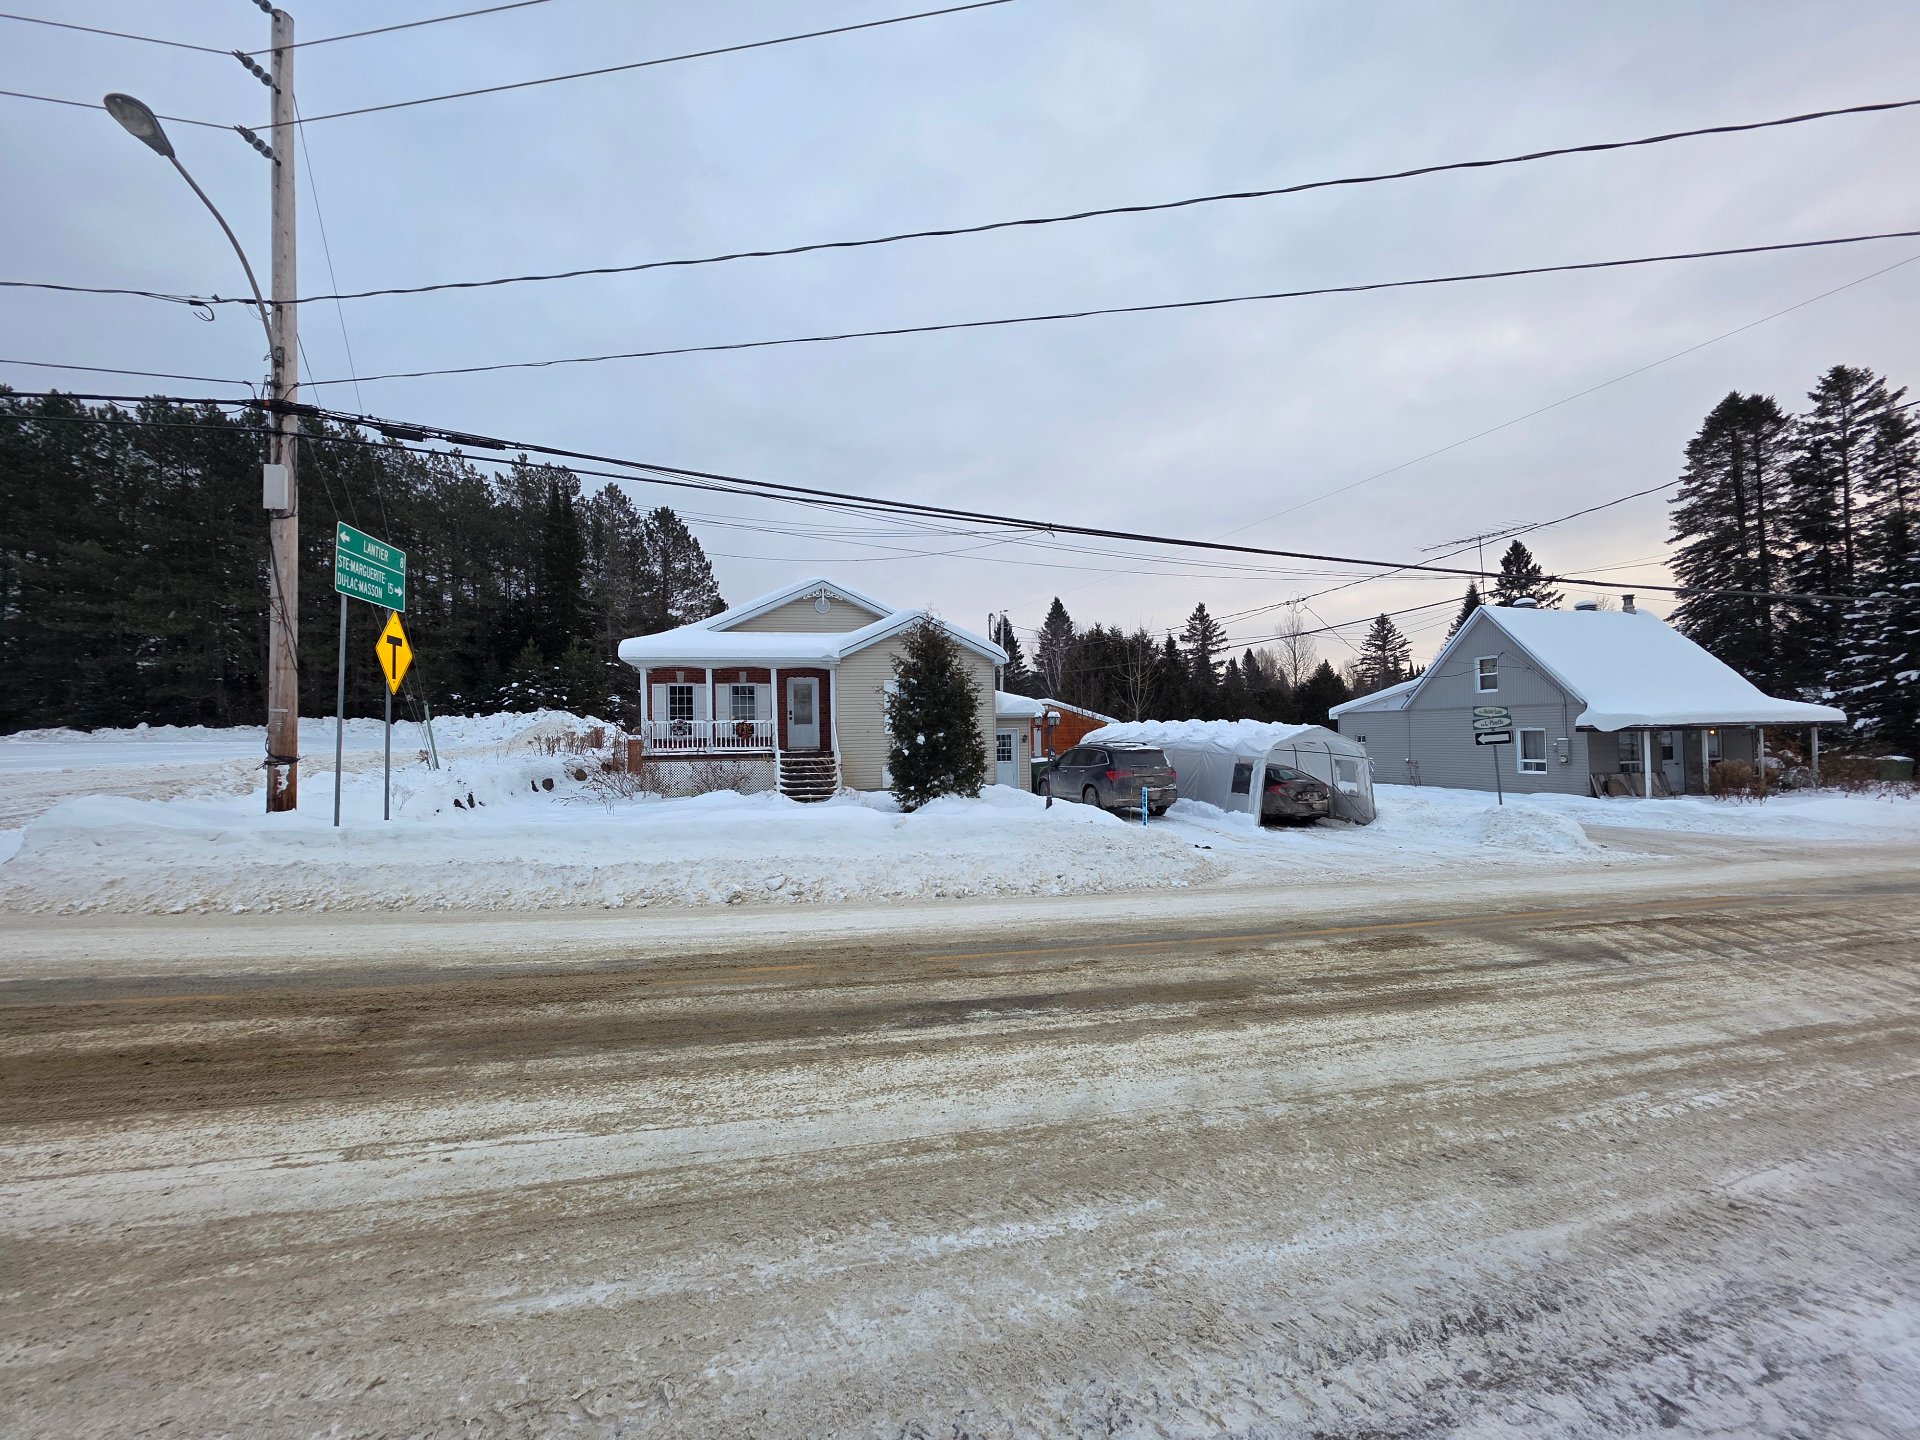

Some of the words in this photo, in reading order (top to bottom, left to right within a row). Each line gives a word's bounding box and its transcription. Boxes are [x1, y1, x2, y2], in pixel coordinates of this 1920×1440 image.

[363, 540, 389, 562] LANTIER
[399, 557, 404, 569] 8
[337, 572, 383, 599] DU-LAC-MASSON
[387, 582, 394, 595] 15
